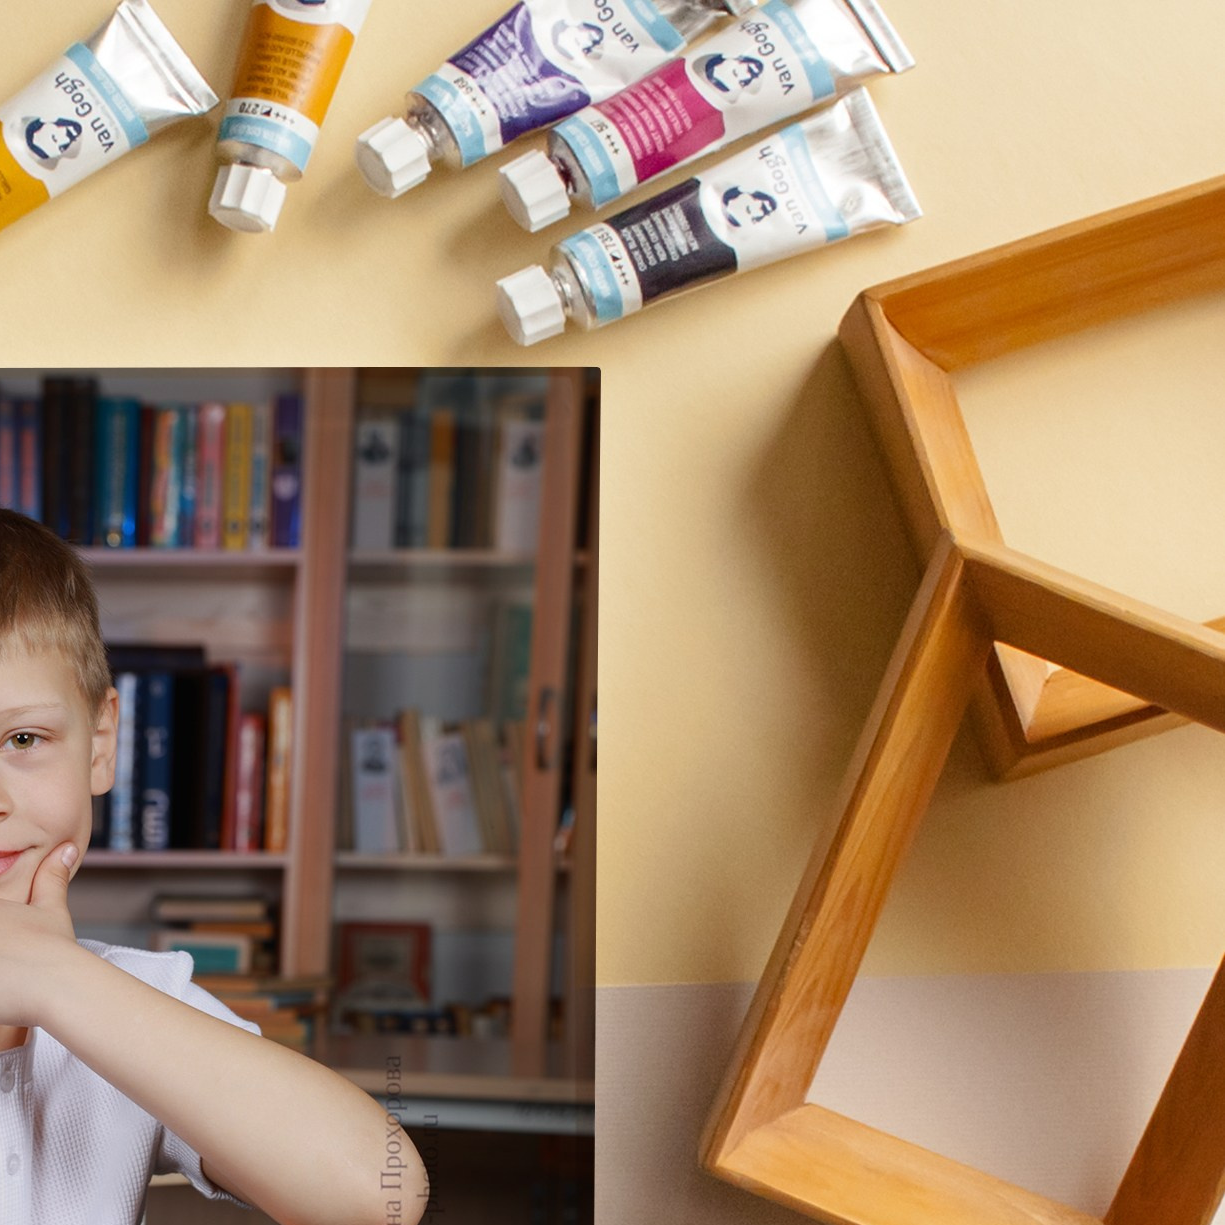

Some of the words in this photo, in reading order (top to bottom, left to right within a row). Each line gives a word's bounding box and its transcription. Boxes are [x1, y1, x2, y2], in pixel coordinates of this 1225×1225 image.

[609, 21, 638, 53] van
[738, 20, 775, 57] Gogh
[770, 56, 795, 95] van
[54, 71, 93, 119] Gogh
[88, 116, 115, 153] van
[758, 144, 789, 196] Gogh
[783, 198, 806, 234] van
